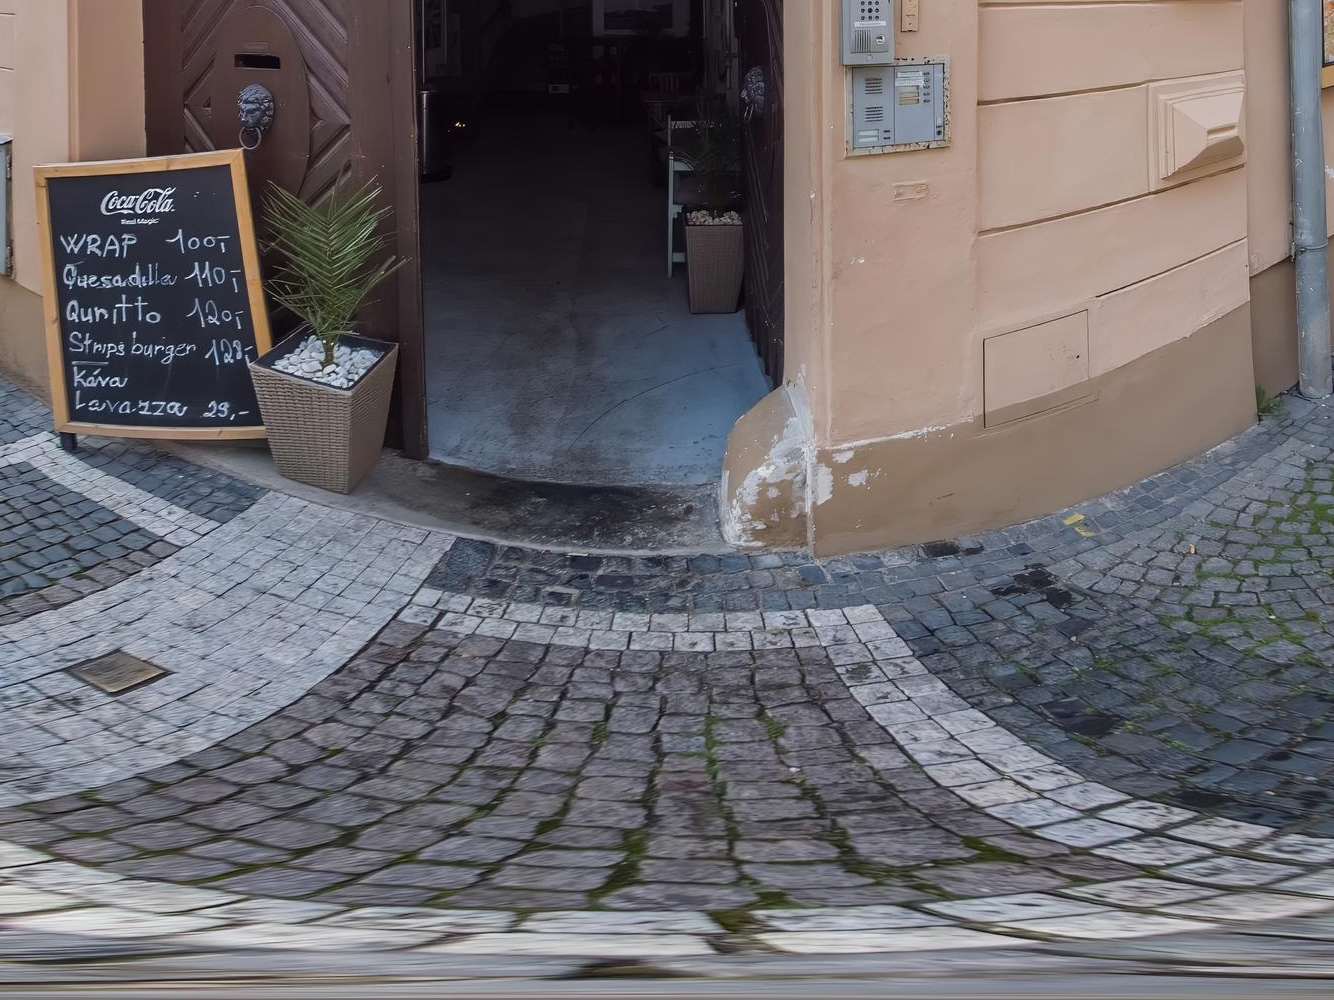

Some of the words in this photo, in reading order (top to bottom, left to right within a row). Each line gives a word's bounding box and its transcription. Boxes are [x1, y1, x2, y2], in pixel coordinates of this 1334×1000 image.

[60, 233, 138, 258] WRAP
[62, 262, 178, 289] Quesadilla
[69, 332, 125, 359] Strips
[130, 331, 197, 364] burger
[73, 366, 129, 388] Káva
[75, 390, 189, 417] Lavazza
